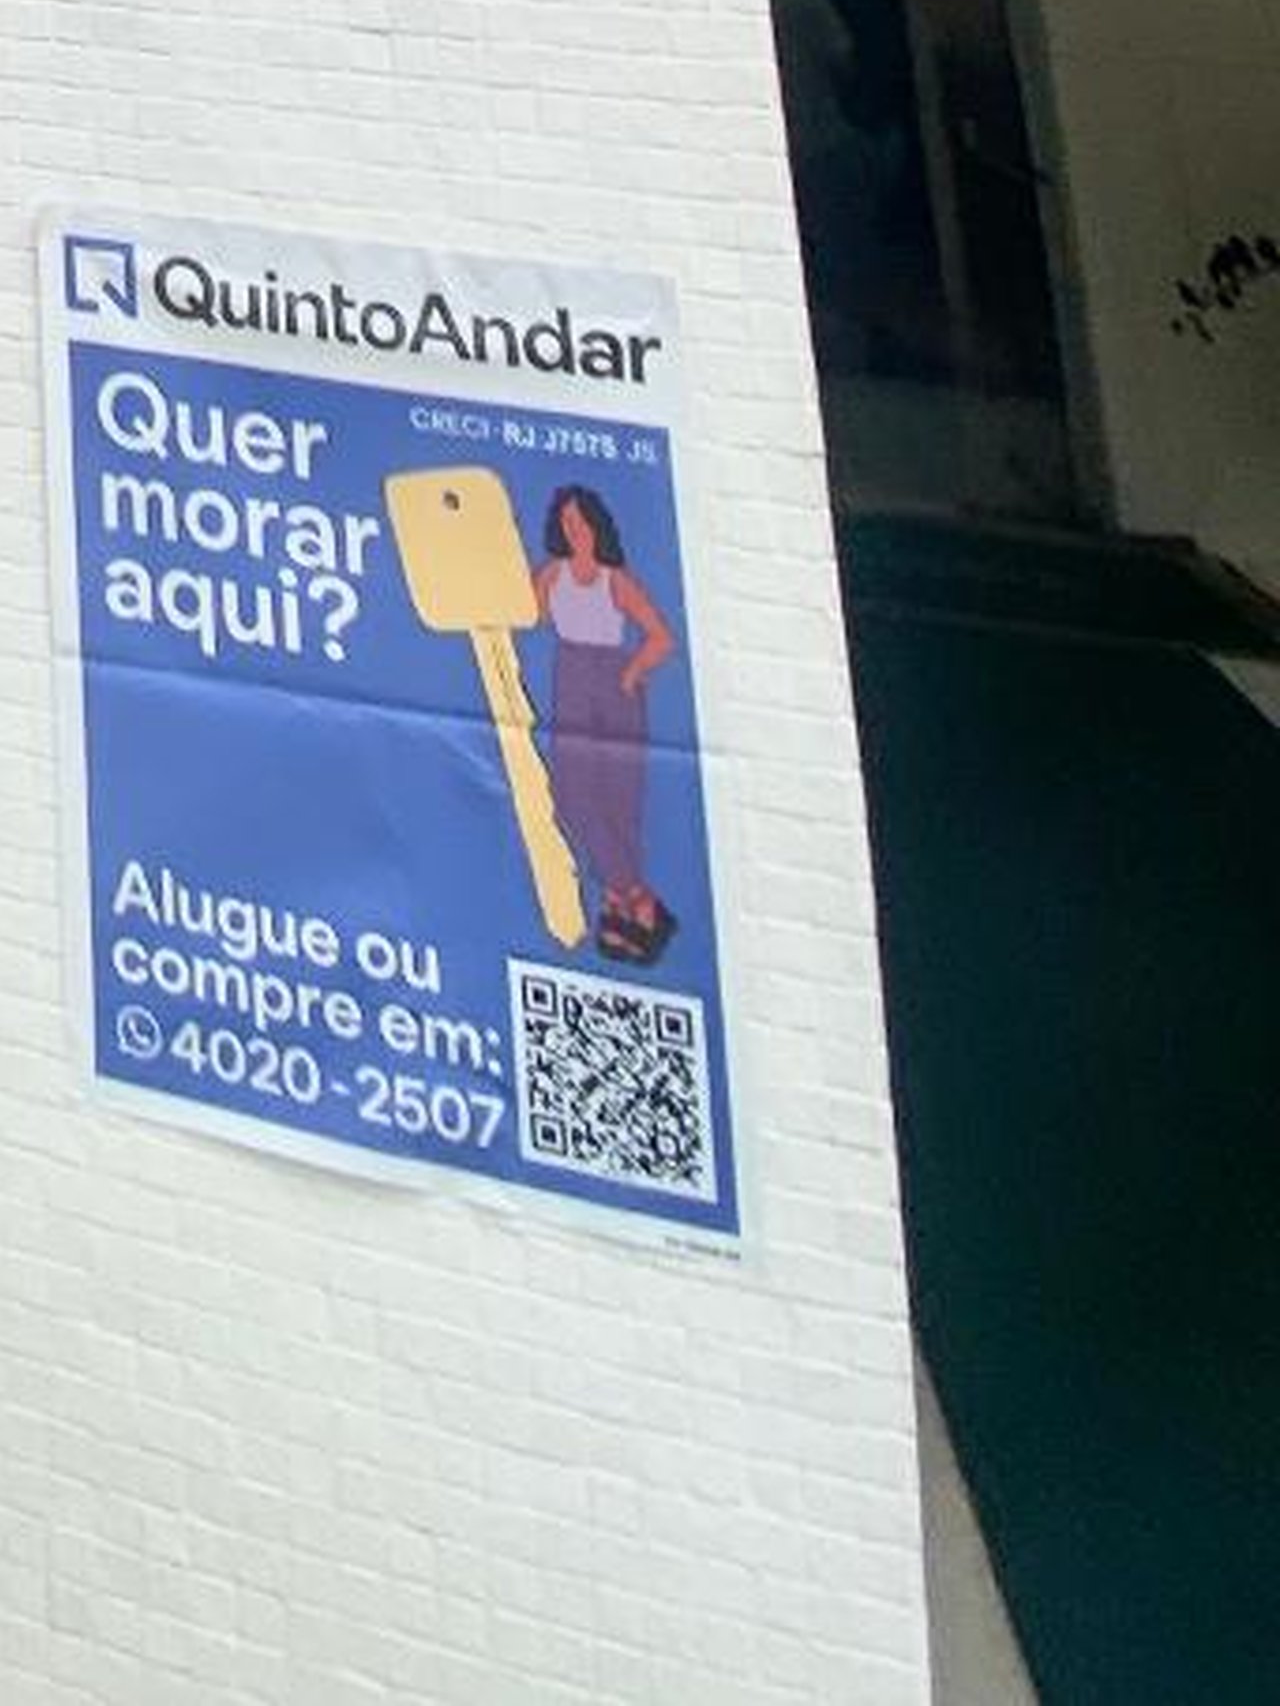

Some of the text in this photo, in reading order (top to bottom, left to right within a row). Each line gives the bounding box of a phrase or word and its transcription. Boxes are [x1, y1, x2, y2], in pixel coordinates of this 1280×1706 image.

[152, 254, 663, 385] QuintoAndar
[96, 370, 329, 481] Quer
[100, 471, 381, 577] morar
[104, 557, 359, 663] aqui?
[112, 859, 441, 994] Alugue ou
[112, 937, 502, 1077] compre em:
